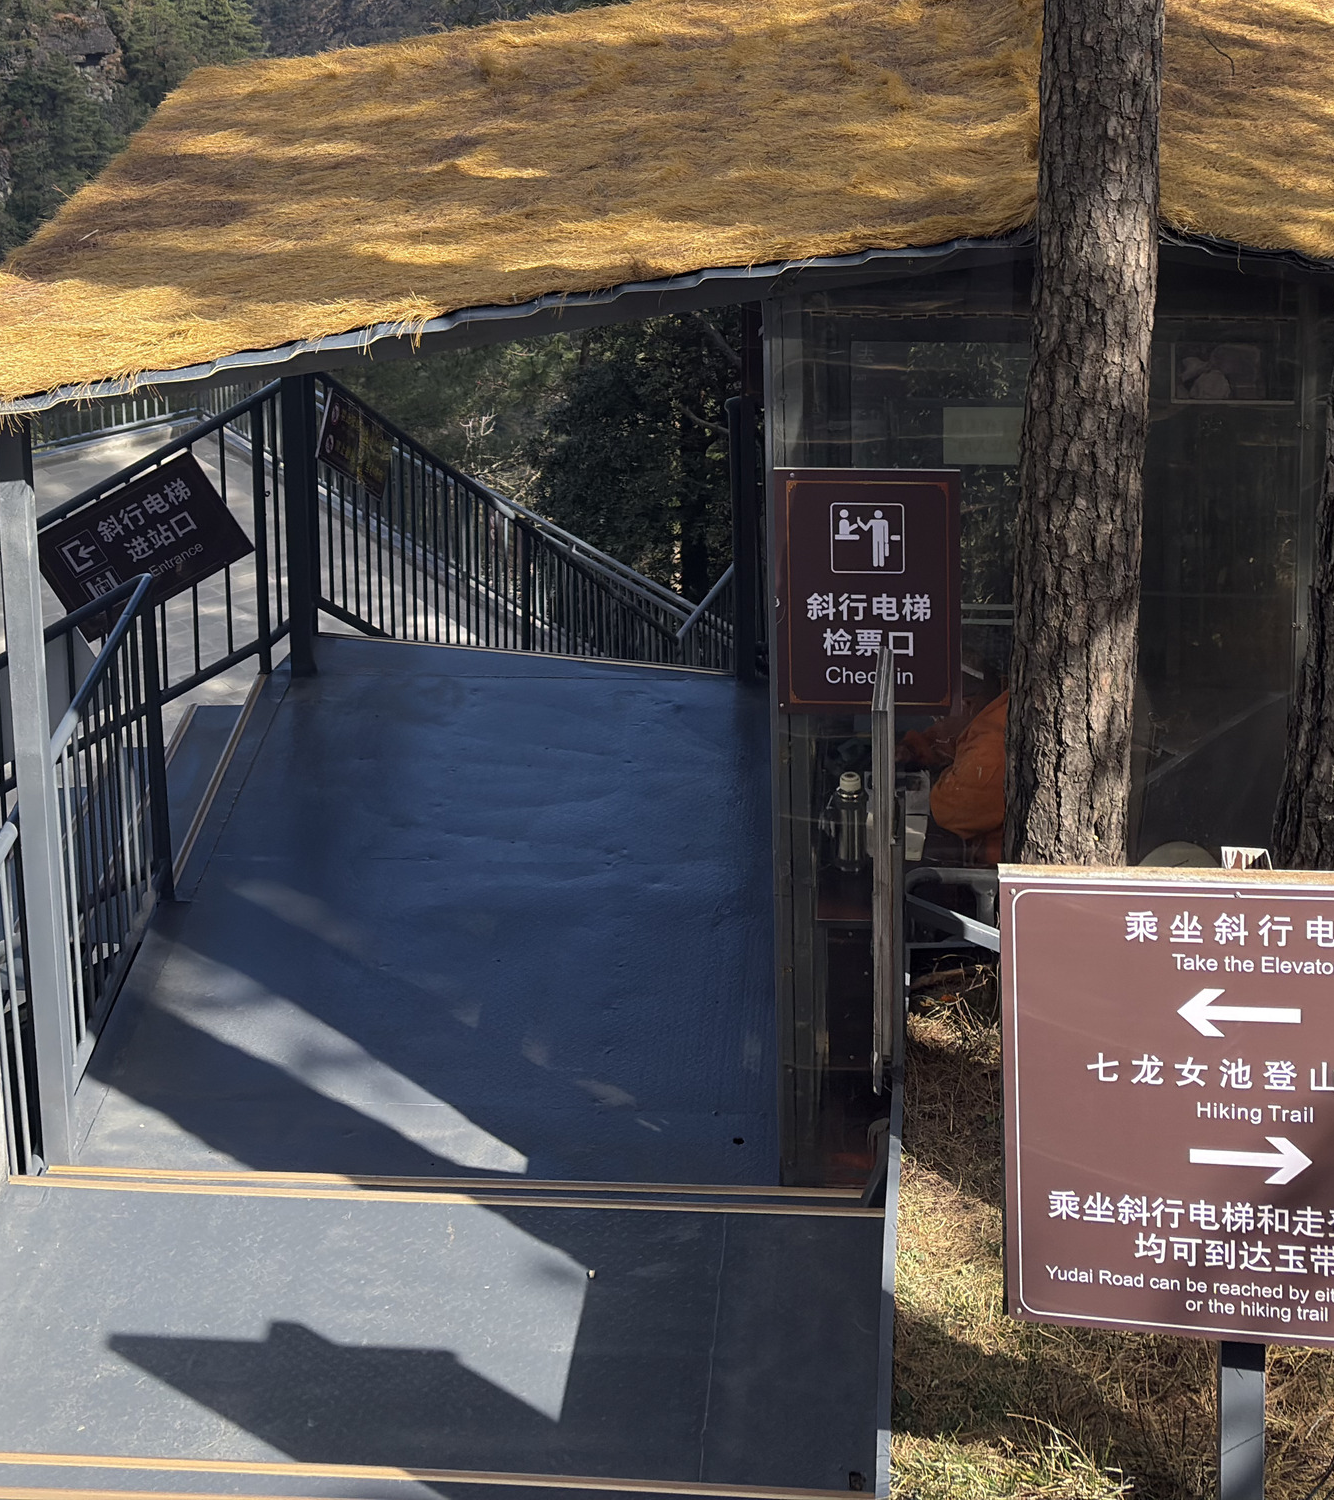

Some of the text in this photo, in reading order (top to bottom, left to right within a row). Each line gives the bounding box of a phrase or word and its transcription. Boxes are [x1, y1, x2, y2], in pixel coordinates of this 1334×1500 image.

[97, 478, 191, 542] 斜行电梯
[123, 511, 197, 562] 进站口
[148, 543, 204, 577] Entrance
[806, 592, 932, 622] 斜行电梯
[823, 628, 914, 657] 检票口
[825, 666, 877, 684] Chec
[1171, 953, 1218, 972] Take
[1223, 955, 1254, 973] the
[1196, 1102, 1315, 1125] Hiking Trail
[1045, 1265, 1093, 1284] Yudai
[1098, 1269, 1144, 1288] Road
[1149, 1276, 1181, 1291] can
[1186, 1277, 1208, 1293] be
[1213, 1282, 1283, 1299] reached
[1288, 1285, 1310, 1304] by
[1185, 1298, 1329, 1322] or the hiking trail
